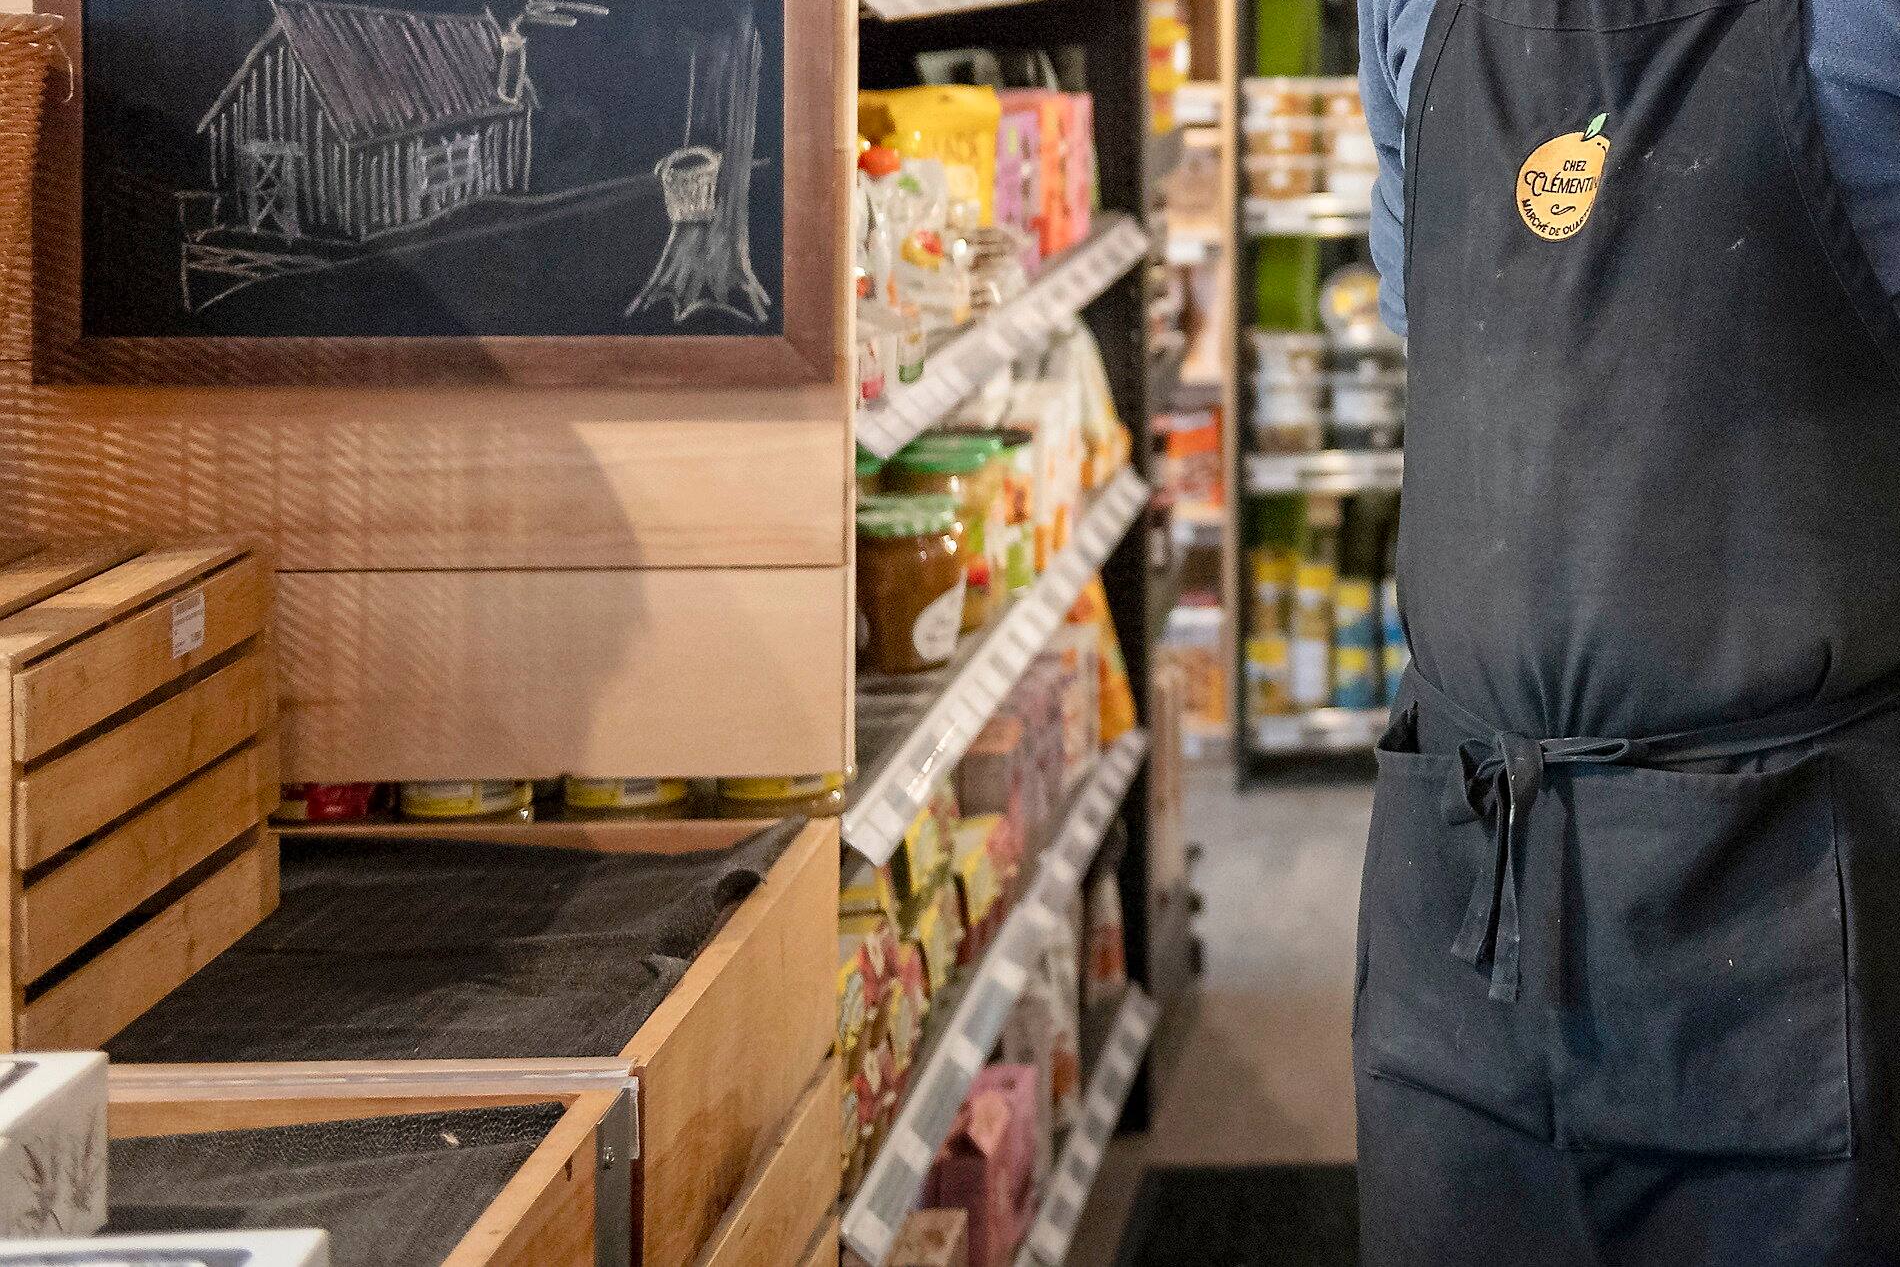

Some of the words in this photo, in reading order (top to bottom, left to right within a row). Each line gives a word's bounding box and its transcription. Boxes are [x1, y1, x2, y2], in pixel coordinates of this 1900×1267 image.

[1563, 160, 1587, 172] CHEZ
[1521, 199, 1550, 233] MARCHÉ
[1548, 227, 1561, 236] DE
